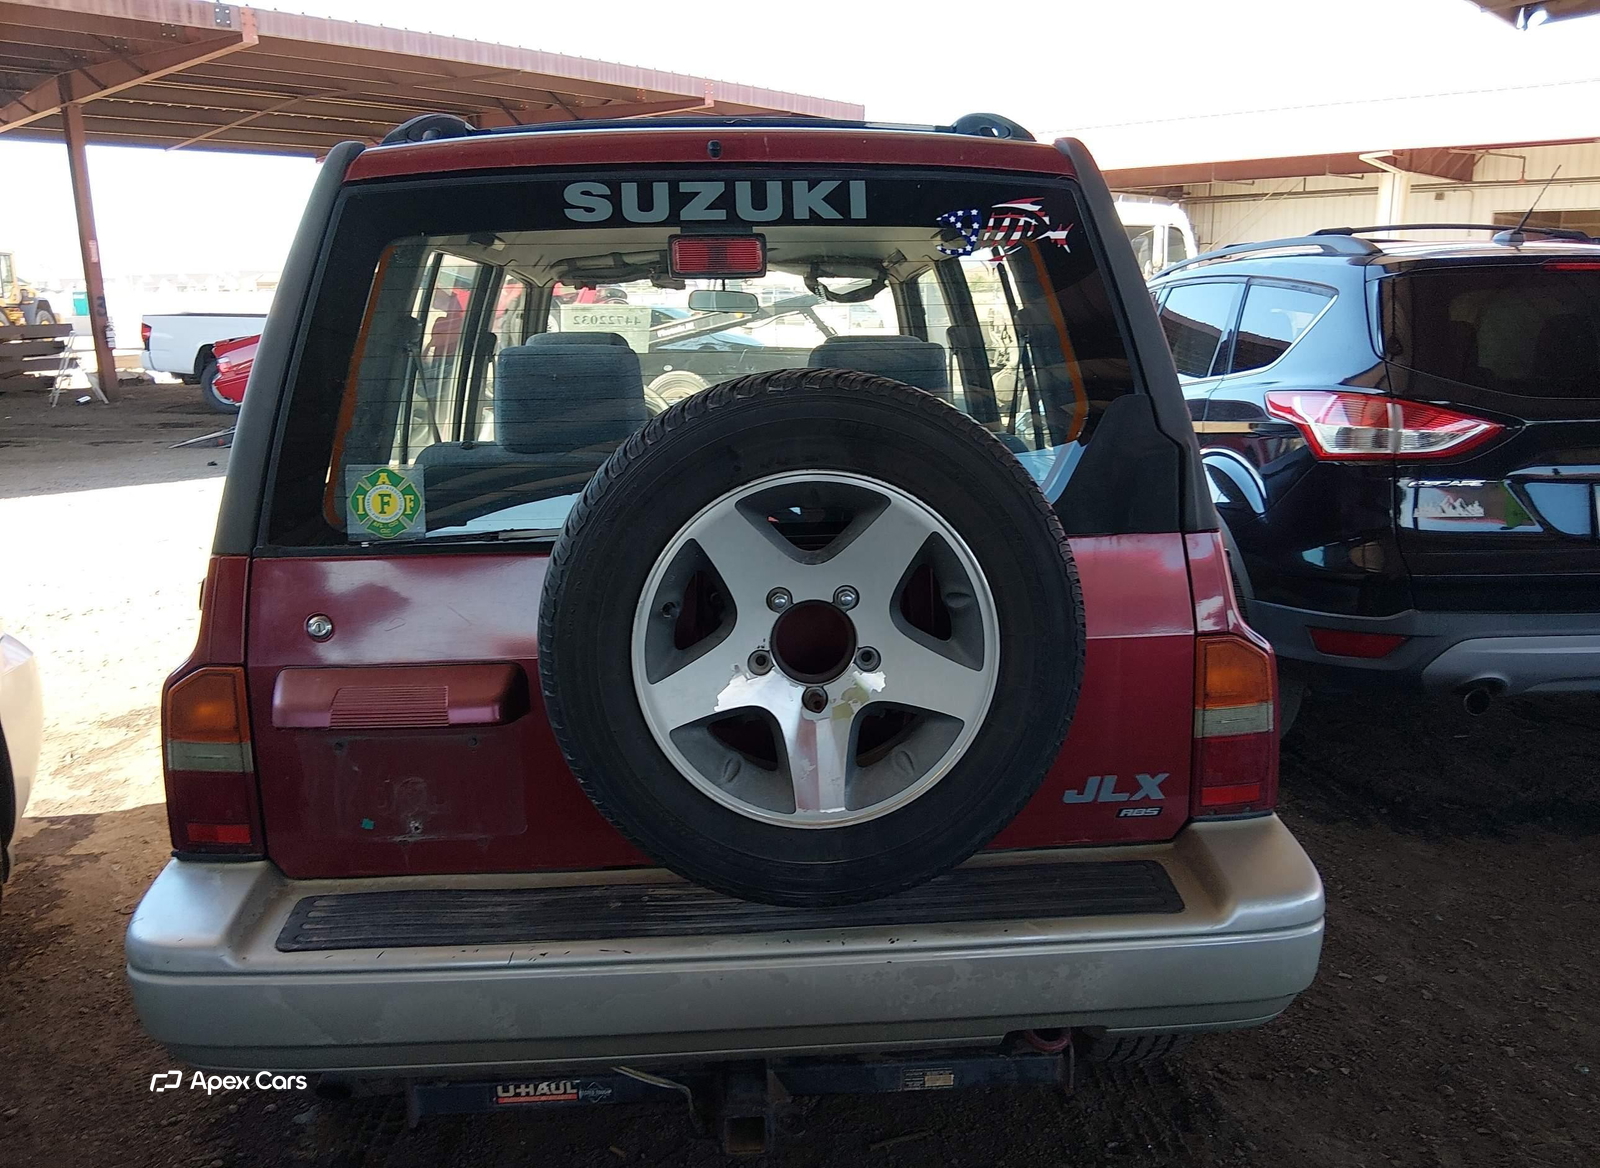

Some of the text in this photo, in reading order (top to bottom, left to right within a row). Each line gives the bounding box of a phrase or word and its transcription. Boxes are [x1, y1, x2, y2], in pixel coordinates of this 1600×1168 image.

[562, 179, 868, 223] SUZUKI
[376, 472, 391, 485] A
[377, 493, 392, 515] F
[404, 495, 415, 515] F
[1062, 773, 1170, 804] JLX
[1119, 807, 1161, 818] ABS
[496, 1080, 579, 1098] U-HAUL
